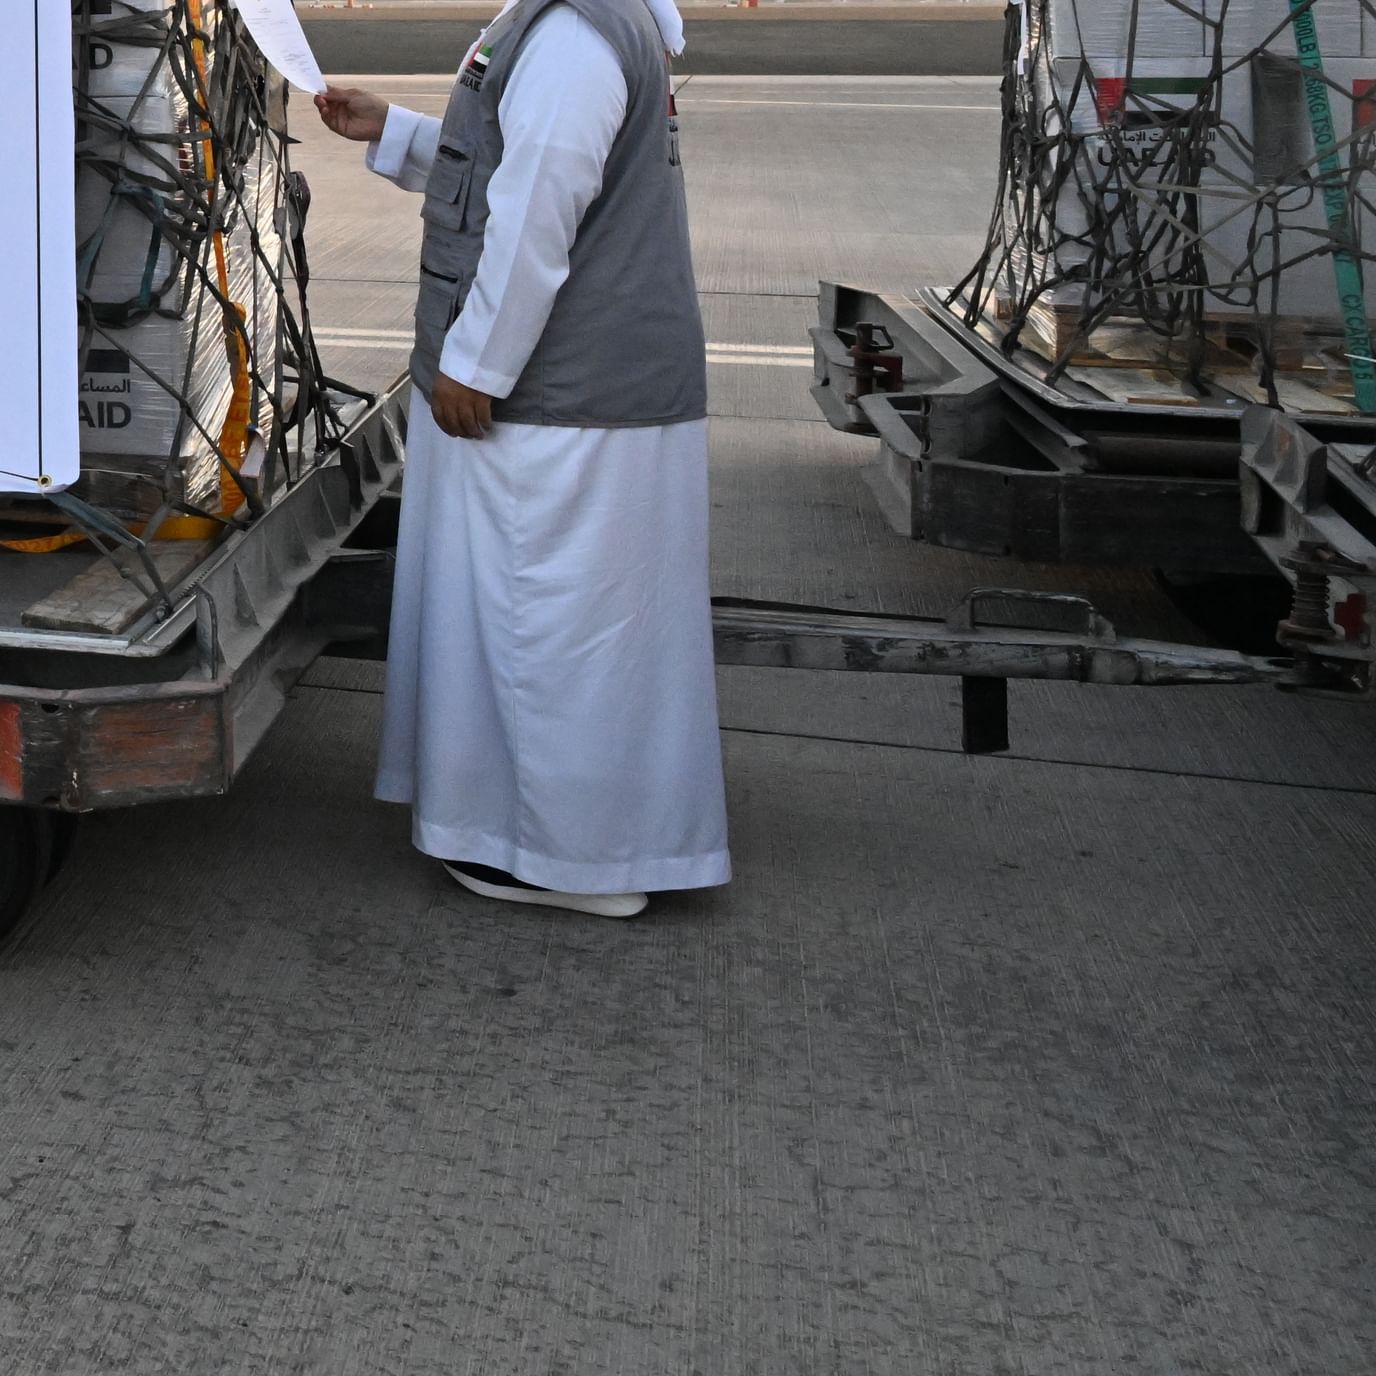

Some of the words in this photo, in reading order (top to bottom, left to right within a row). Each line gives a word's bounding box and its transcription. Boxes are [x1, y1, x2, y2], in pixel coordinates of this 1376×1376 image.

[1294, 6, 1317, 54] 000LB
[1312, 117, 1333, 144] TSO
[1342, 294, 1362, 309] CX
[1346, 317, 1371, 368] CARGO
[80, 377, 131, 393] المساع
[78, 401, 132, 429] AID
